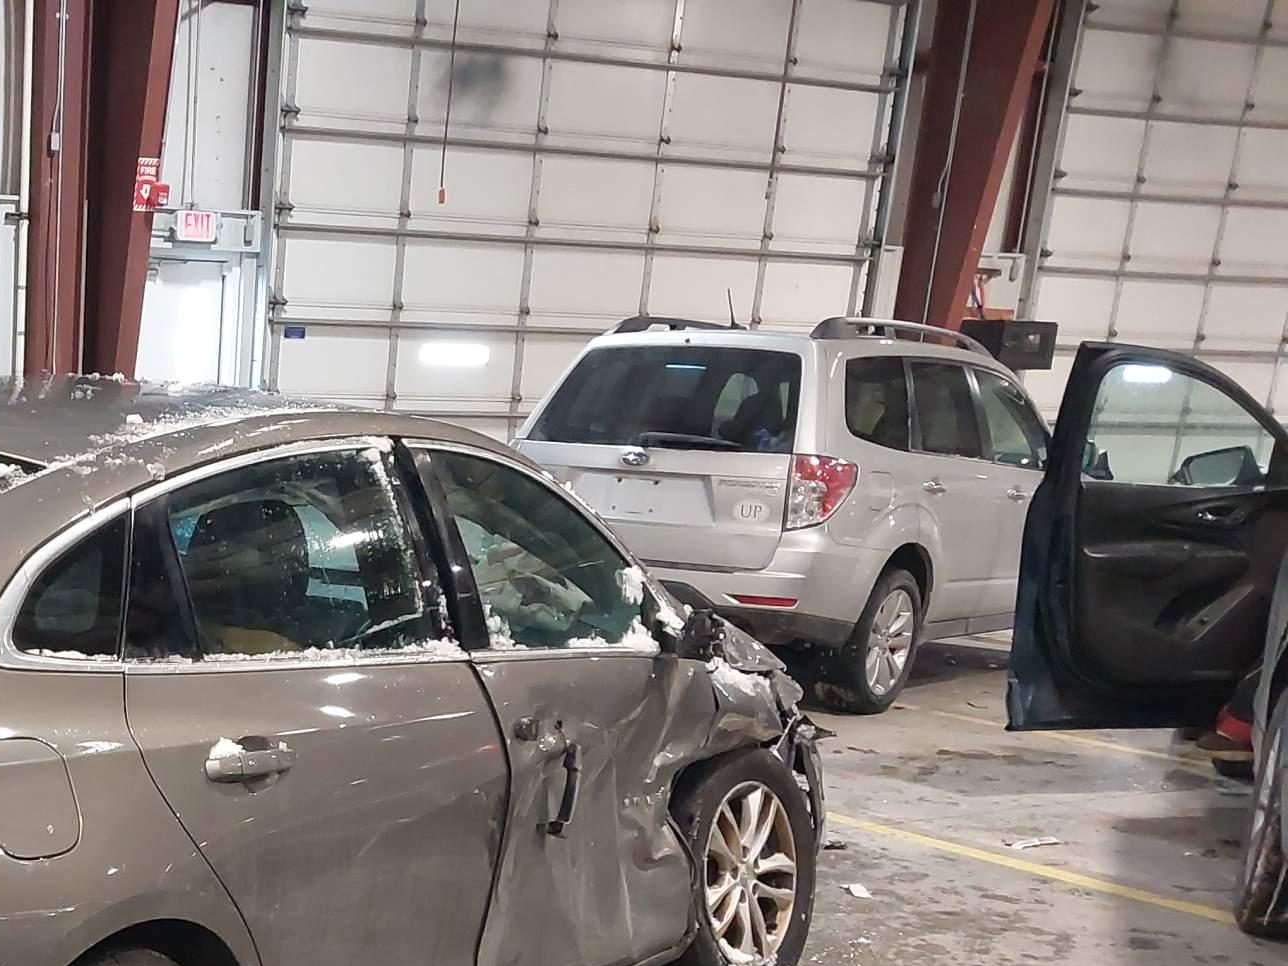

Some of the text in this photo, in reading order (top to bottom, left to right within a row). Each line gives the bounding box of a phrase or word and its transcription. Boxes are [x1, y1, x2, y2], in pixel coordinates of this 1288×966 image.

[140, 166, 157, 175] FIRE
[184, 213, 212, 238] EXIT
[740, 504, 762, 519] UP
